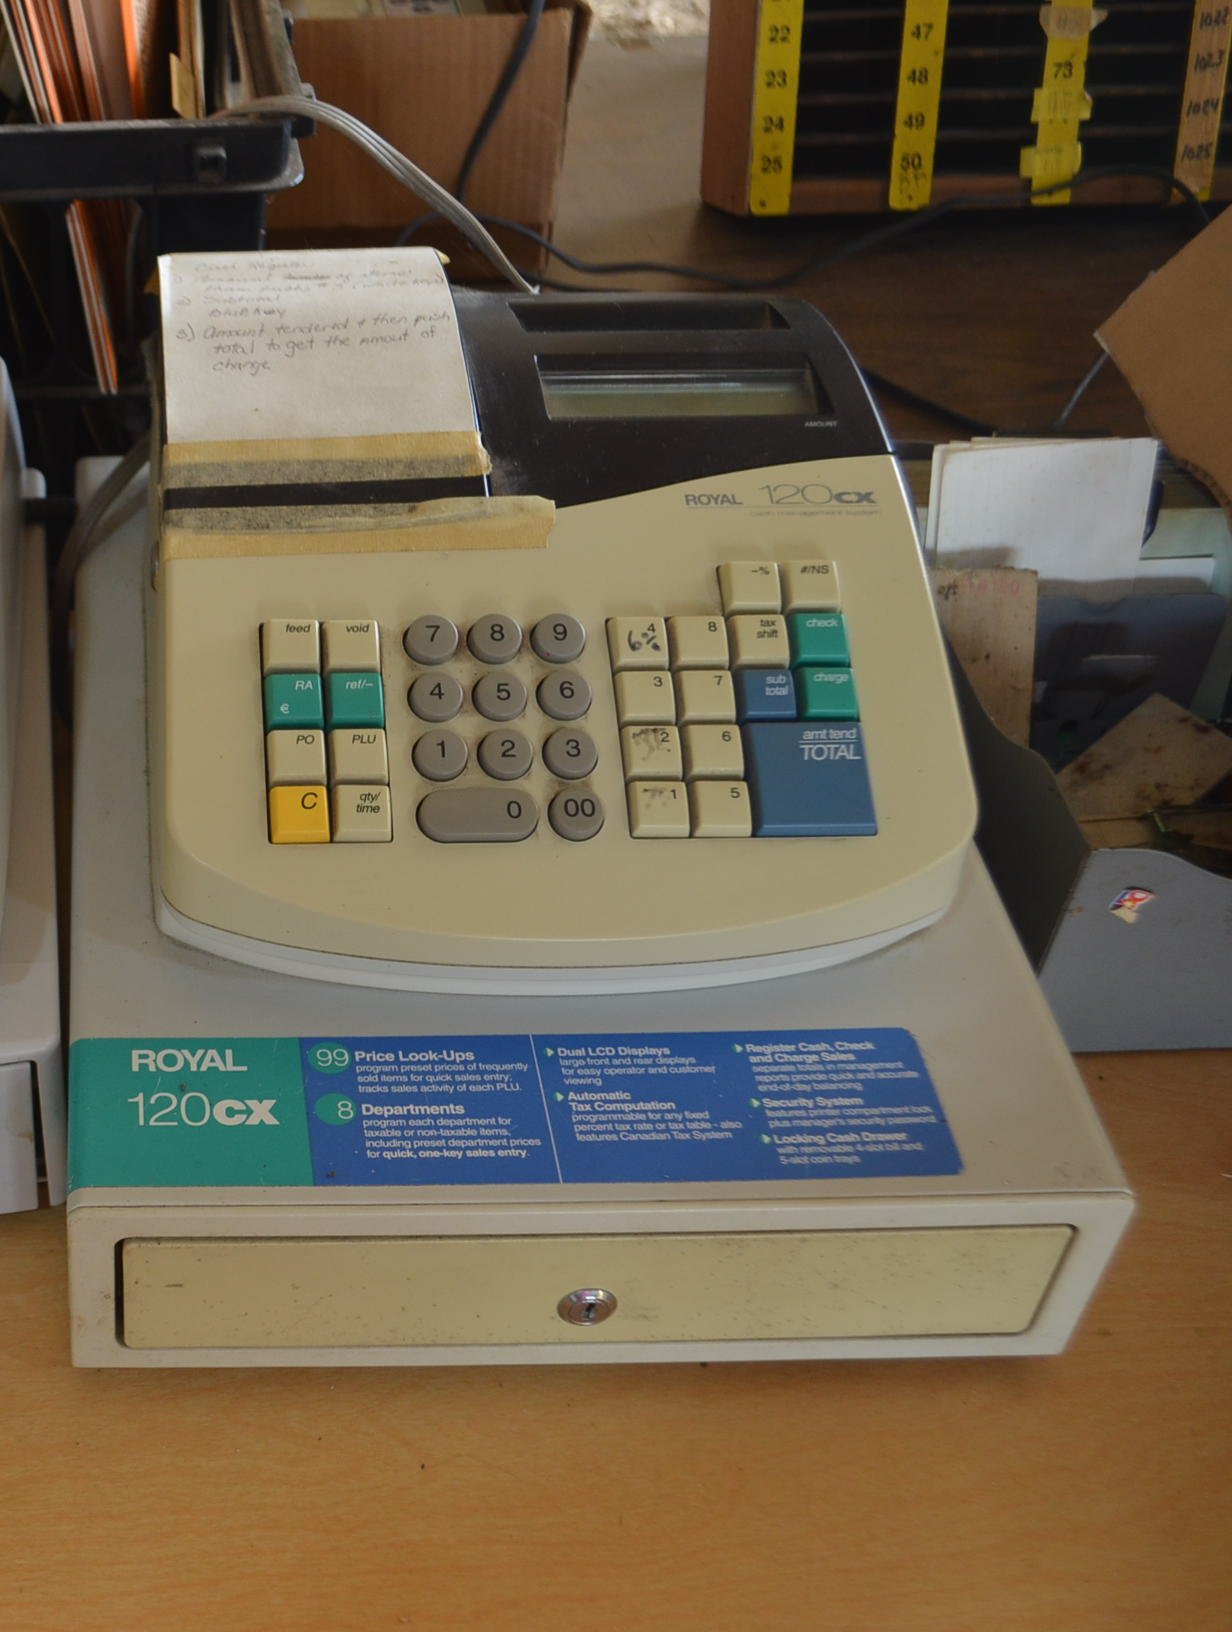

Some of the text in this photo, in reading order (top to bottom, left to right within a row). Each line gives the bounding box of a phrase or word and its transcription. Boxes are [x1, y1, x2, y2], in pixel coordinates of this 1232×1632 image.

[769, 24, 791, 42] 22
[911, 23, 934, 40] 47
[907, 67, 928, 84] 48
[1053, 60, 1074, 79] 73
[765, 70, 787, 88] 23
[762, 115, 784, 133] 24
[903, 113, 925, 129] 49
[761, 155, 783, 173] 25
[900, 153, 922, 171] 50
[685, 494, 743, 506] ROYAL
[285, 624, 311, 633] feed
[346, 624, 369, 633] void
[708, 622, 717, 632] 8
[760, 619, 776, 627] tax
[806, 618, 838, 628] check
[425, 625, 440, 642] 7
[490, 624, 505, 642] 8
[553, 623, 567, 641] 9
[757, 629, 779, 638] shift
[654, 676, 663, 687] 3
[714, 676, 723, 686] 7
[766, 675, 787, 684] sub
[814, 672, 849, 683] charge
[295, 680, 313, 690] RA
[429, 683, 445, 699] 4
[560, 681, 575, 699] 6
[765, 685, 789, 695] total
[496, 683, 511, 700] 5
[296, 735, 315, 744] PO
[352, 735, 377, 744] PLU
[661, 731, 670, 742] 2
[722, 731, 731, 742] 6
[803, 728, 857, 740] amt tend
[437, 742, 446, 758] 1
[500, 740, 516, 757] 2
[566, 740, 581, 757] 3
[800, 744, 862, 760] TOTAL
[360, 792, 380, 804] qty/
[670, 789, 677, 799] 1
[730, 788, 740, 799] 5
[301, 792, 318, 810] C
[356, 802, 380, 814] time
[507, 801, 522, 819] 0
[563, 799, 595, 817] 00
[558, 1046, 670, 1057] Dual LCD Displays
[746, 1044, 796, 1054] Register
[835, 1042, 875, 1050] Check
[131, 1049, 248, 1072] ROYAL
[316, 1048, 475, 1067] 99 Price Look-Ups
[749, 1052, 856, 1063] and Charge Sales
[356, 1062, 528, 1074] program preset prices of frequently
[357, 1073, 481, 1083] sold items for quick sales
[359, 1083, 522, 1093] tracks sales activity of each PLU.
[569, 1091, 631, 1101] Automatic
[570, 1101, 675, 1112] Tax Computation
[762, 1097, 864, 1108] Security System
[338, 1101, 465, 1120] 8 Departments
[363, 1116, 512, 1128] program each department for
[364, 1127, 477, 1137] taxable or non-taxable
[365, 1137, 541, 1149] including preset department prices
[773, 1135, 824, 1145] Locking
[827, 1133, 860, 1142] Cash
[367, 1149, 380, 1158] for
[383, 1149, 417, 1159] quick,
[419, 1149, 463, 1159] one-key
[466, 1148, 494, 1158] sales
